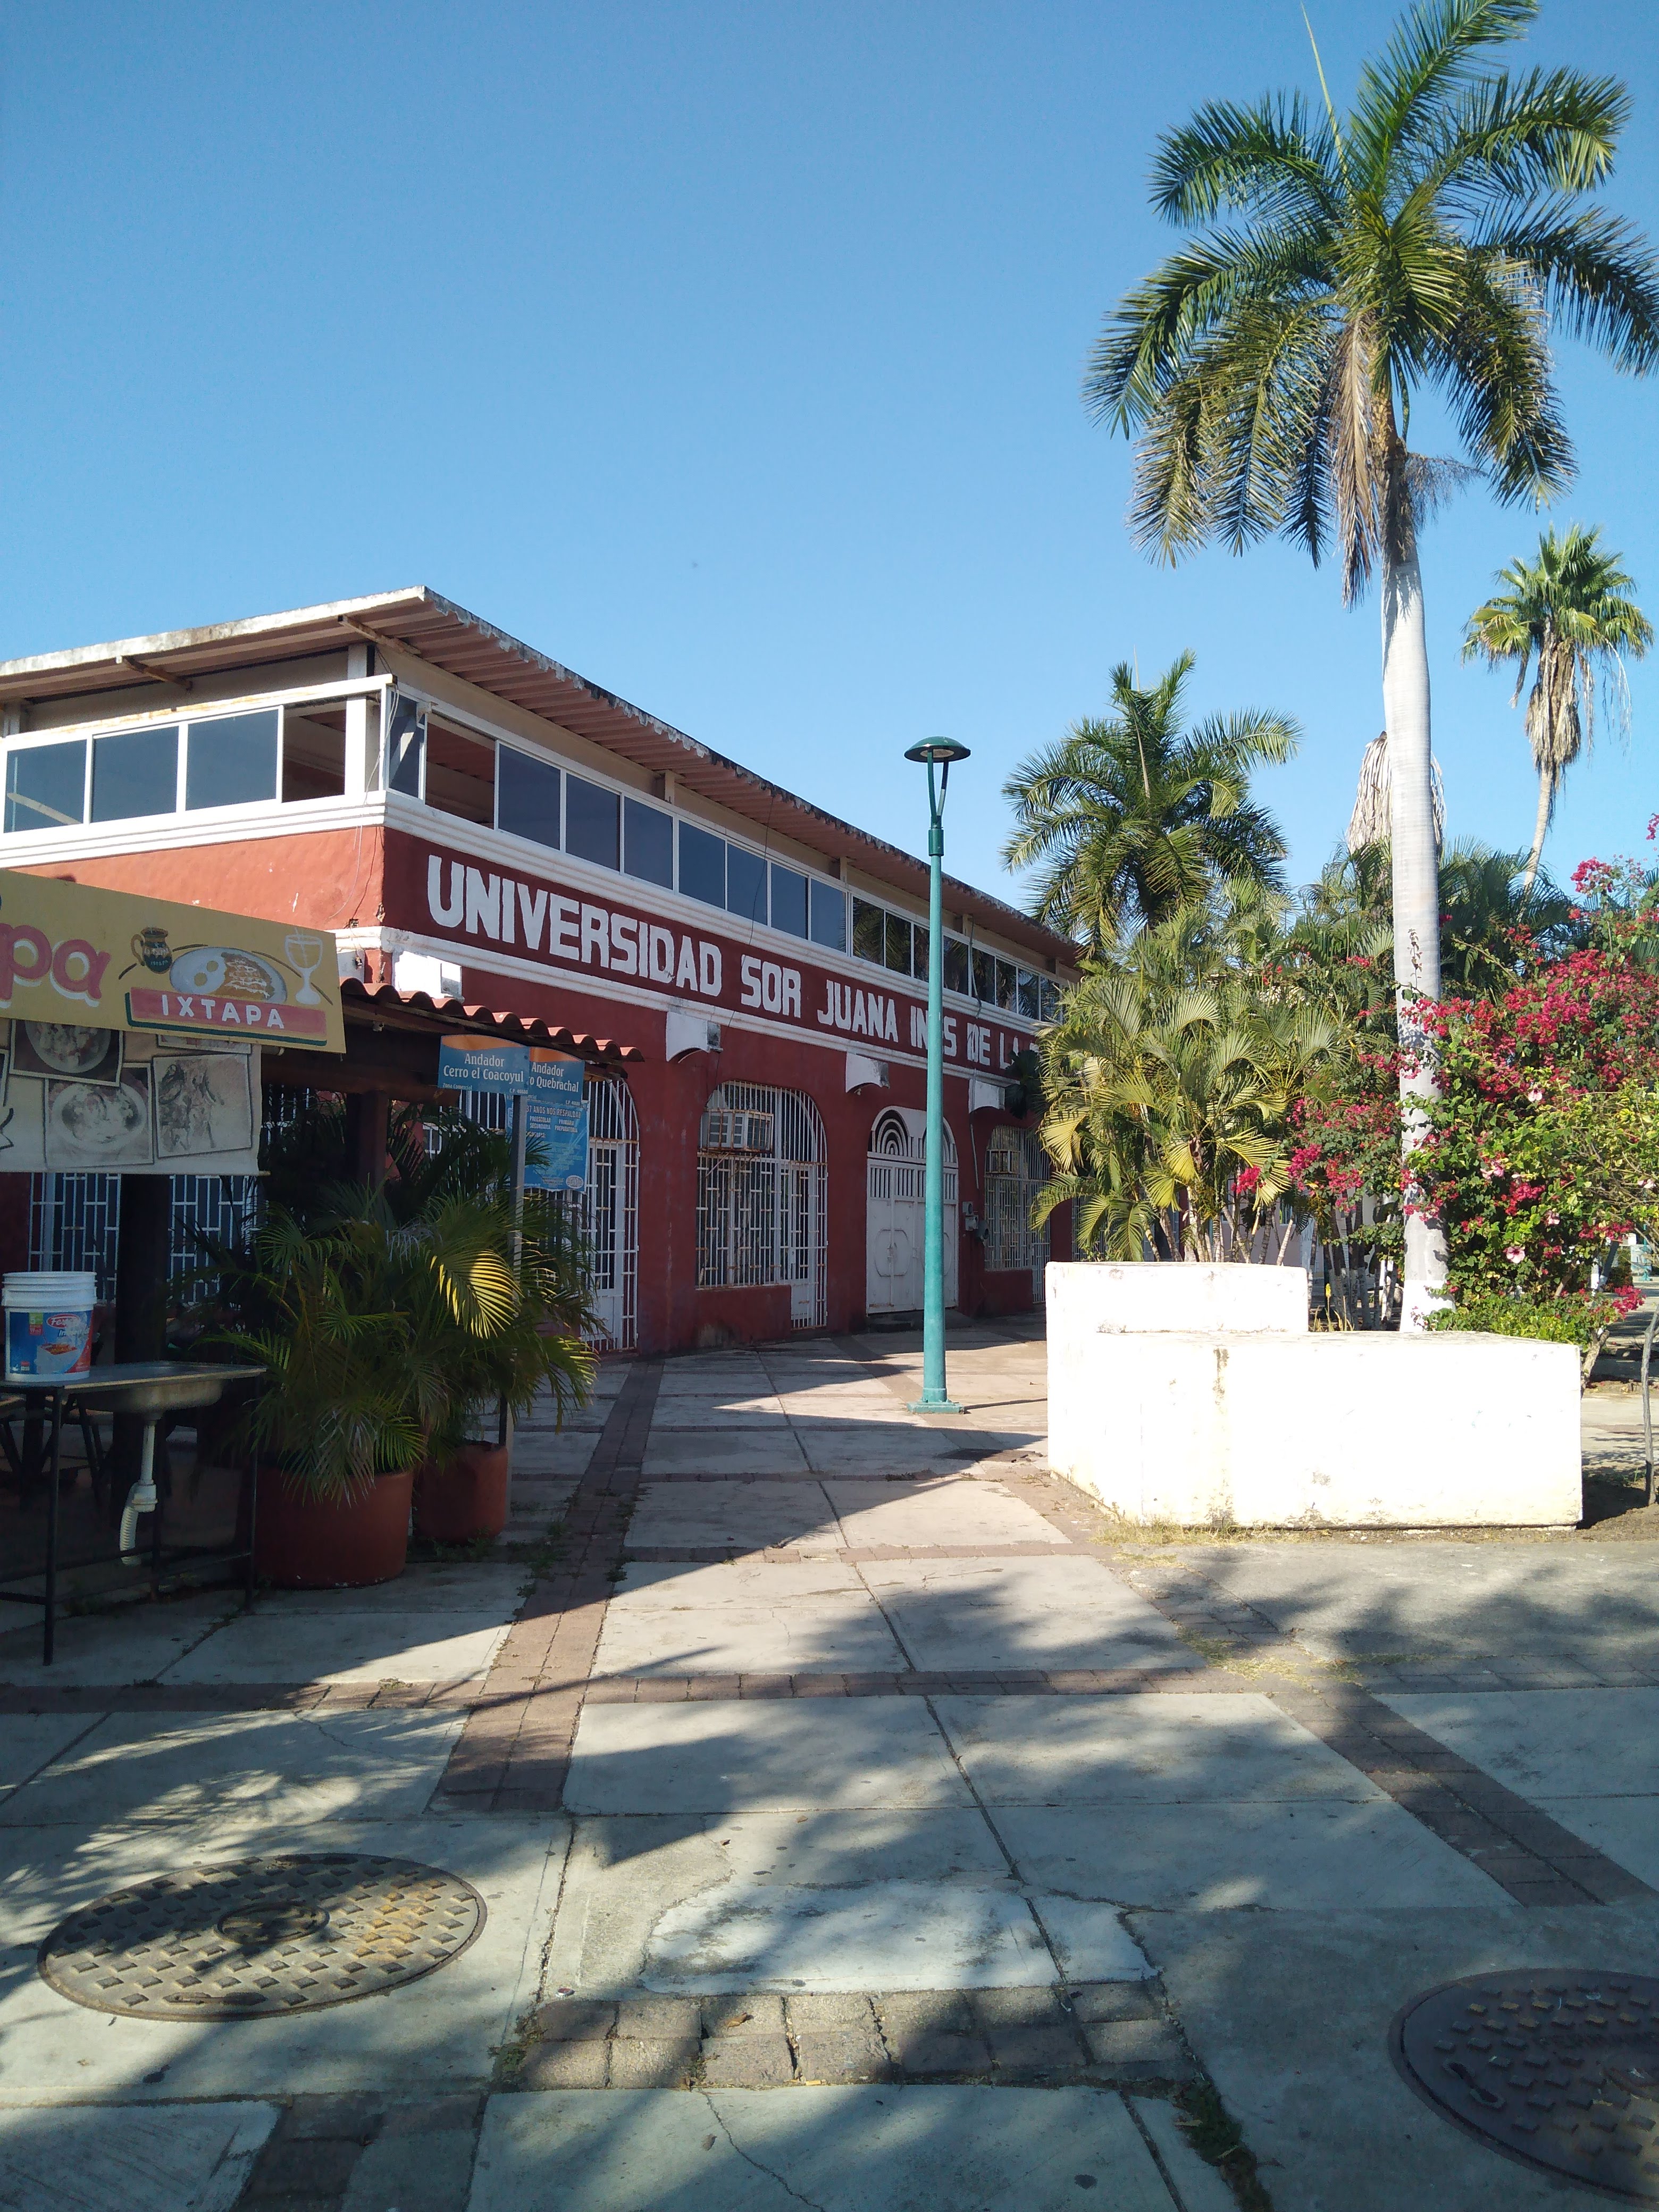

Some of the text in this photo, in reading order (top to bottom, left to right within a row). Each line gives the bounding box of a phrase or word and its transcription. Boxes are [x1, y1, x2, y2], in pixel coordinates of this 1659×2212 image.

[428, 854, 722, 996] UNIVERSIDAD
[741, 954, 801, 1018] SOR
[817, 979, 899, 1042] JUANA
[911, 1006, 957, 1057] INS
[967, 1023, 990, 1066] DE
[162, 994, 284, 1029] IXTAPA
[465, 1053, 505, 1067] Andador
[443, 1065, 524, 1084] Cerro el Coacoyul
[532, 1062, 564, 1077] Andador
[537, 1076, 579, 1092] Quebrachal
[547, 1107, 556, 1116] NOS
